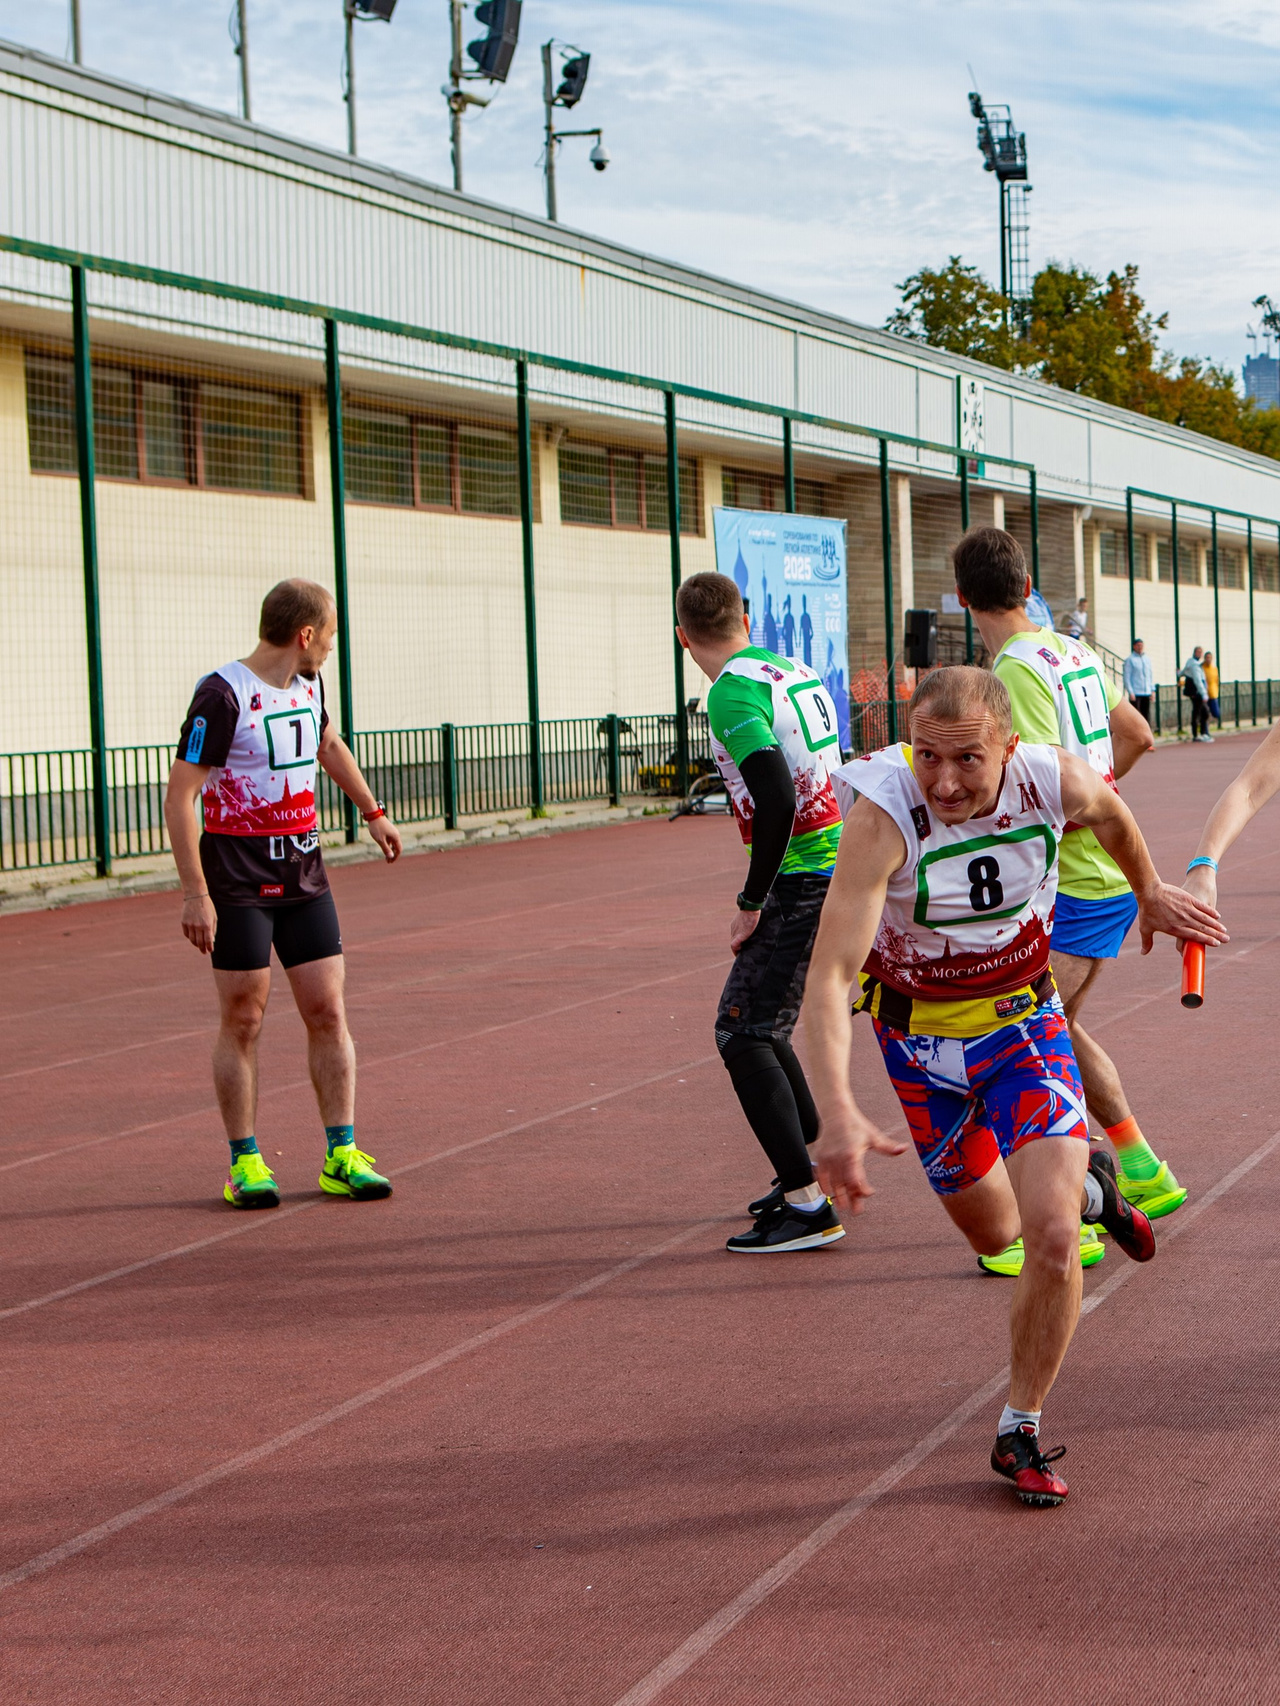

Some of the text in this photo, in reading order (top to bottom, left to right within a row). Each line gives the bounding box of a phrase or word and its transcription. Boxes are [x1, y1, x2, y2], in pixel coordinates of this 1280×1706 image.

[784, 555, 811, 580] 2025
[812, 693, 831, 732] 9
[288, 719, 302, 757] 1
[967, 855, 1004, 912] 8
[931, 937, 1041, 980] МОСКОМСПОРТ
